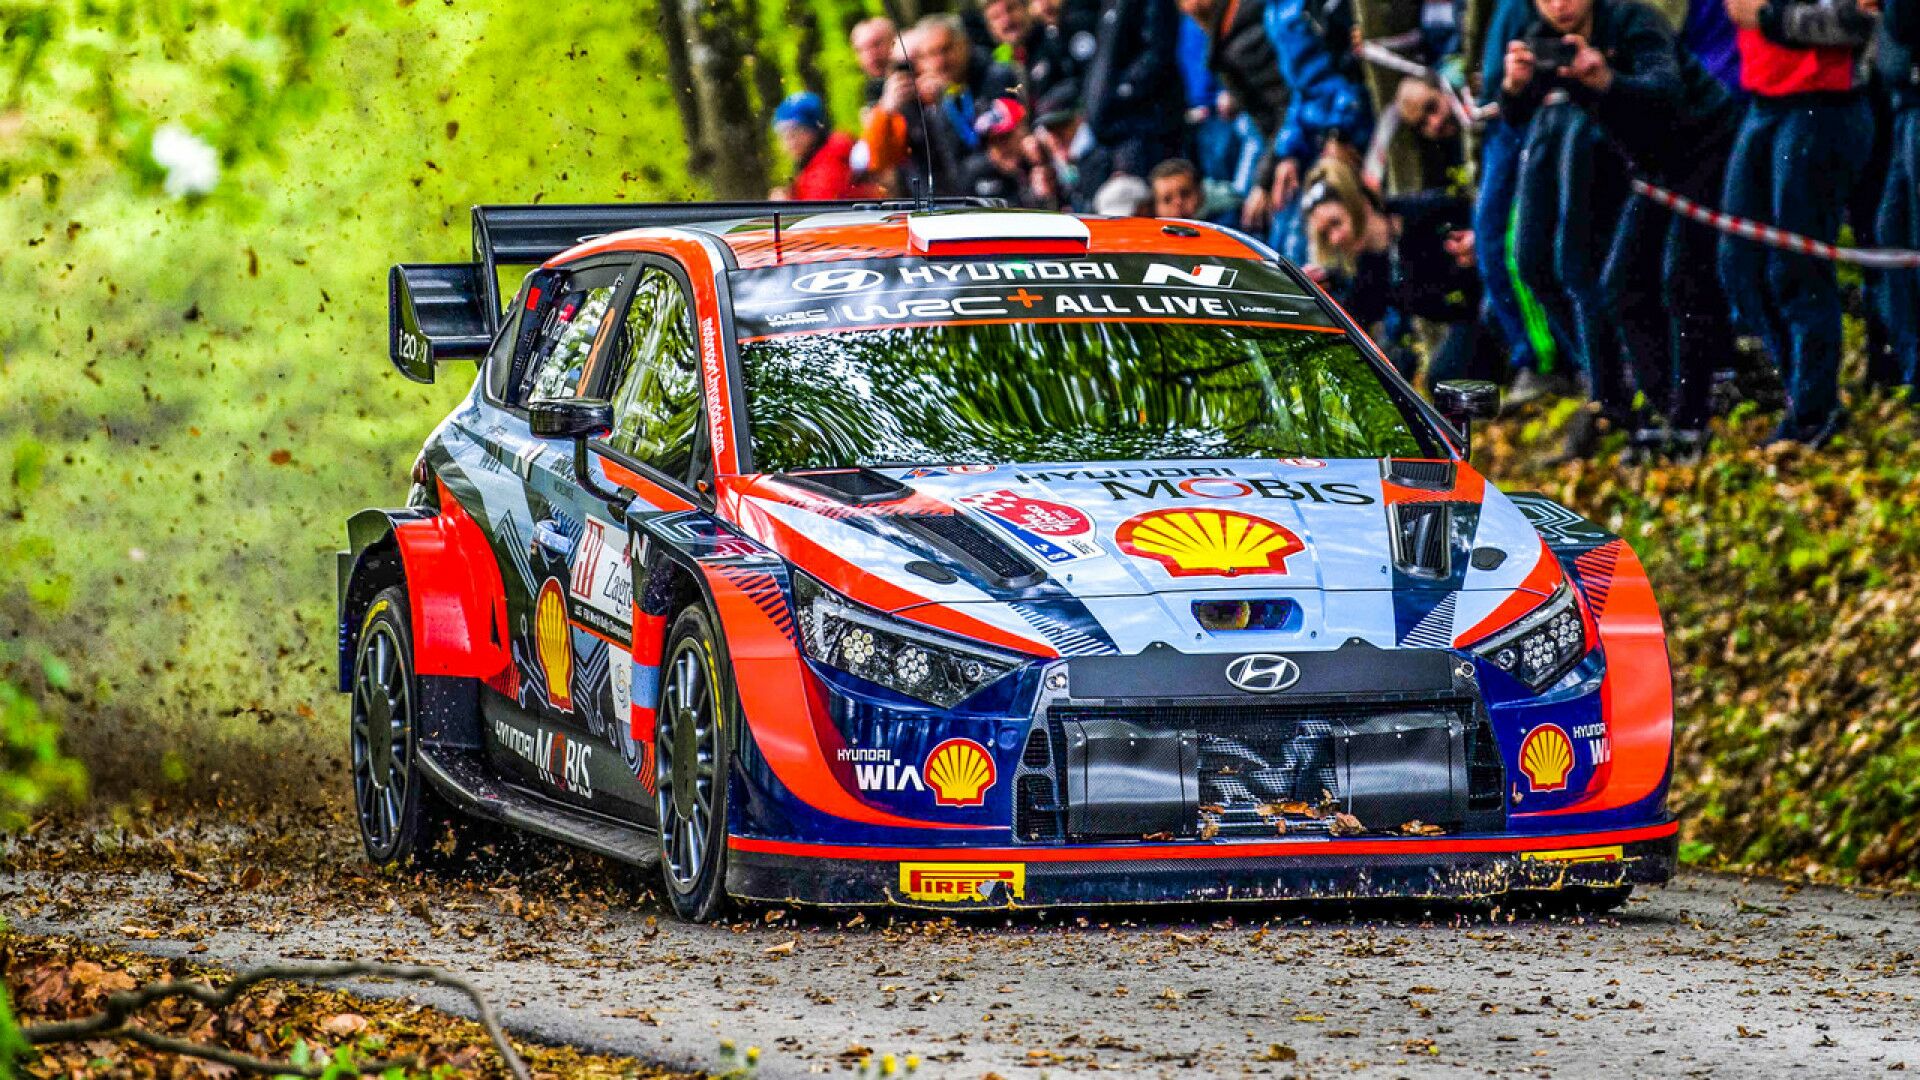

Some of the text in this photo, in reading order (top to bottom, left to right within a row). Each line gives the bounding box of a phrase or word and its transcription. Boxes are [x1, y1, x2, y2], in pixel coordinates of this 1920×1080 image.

[898, 262, 1119, 284] HYUNDAI
[1055, 294, 1131, 313] ALL
[1136, 295, 1229, 316] LIVE
[1014, 467, 1237, 484] HYUNDAI
[1097, 478, 1375, 505] MOBIS
[1573, 722, 1606, 739] HYUNDA
[495, 719, 592, 799] HYUNDAI MOBIS
[837, 748, 890, 762] HYUNDAI
[910, 869, 1015, 894] PIRE
